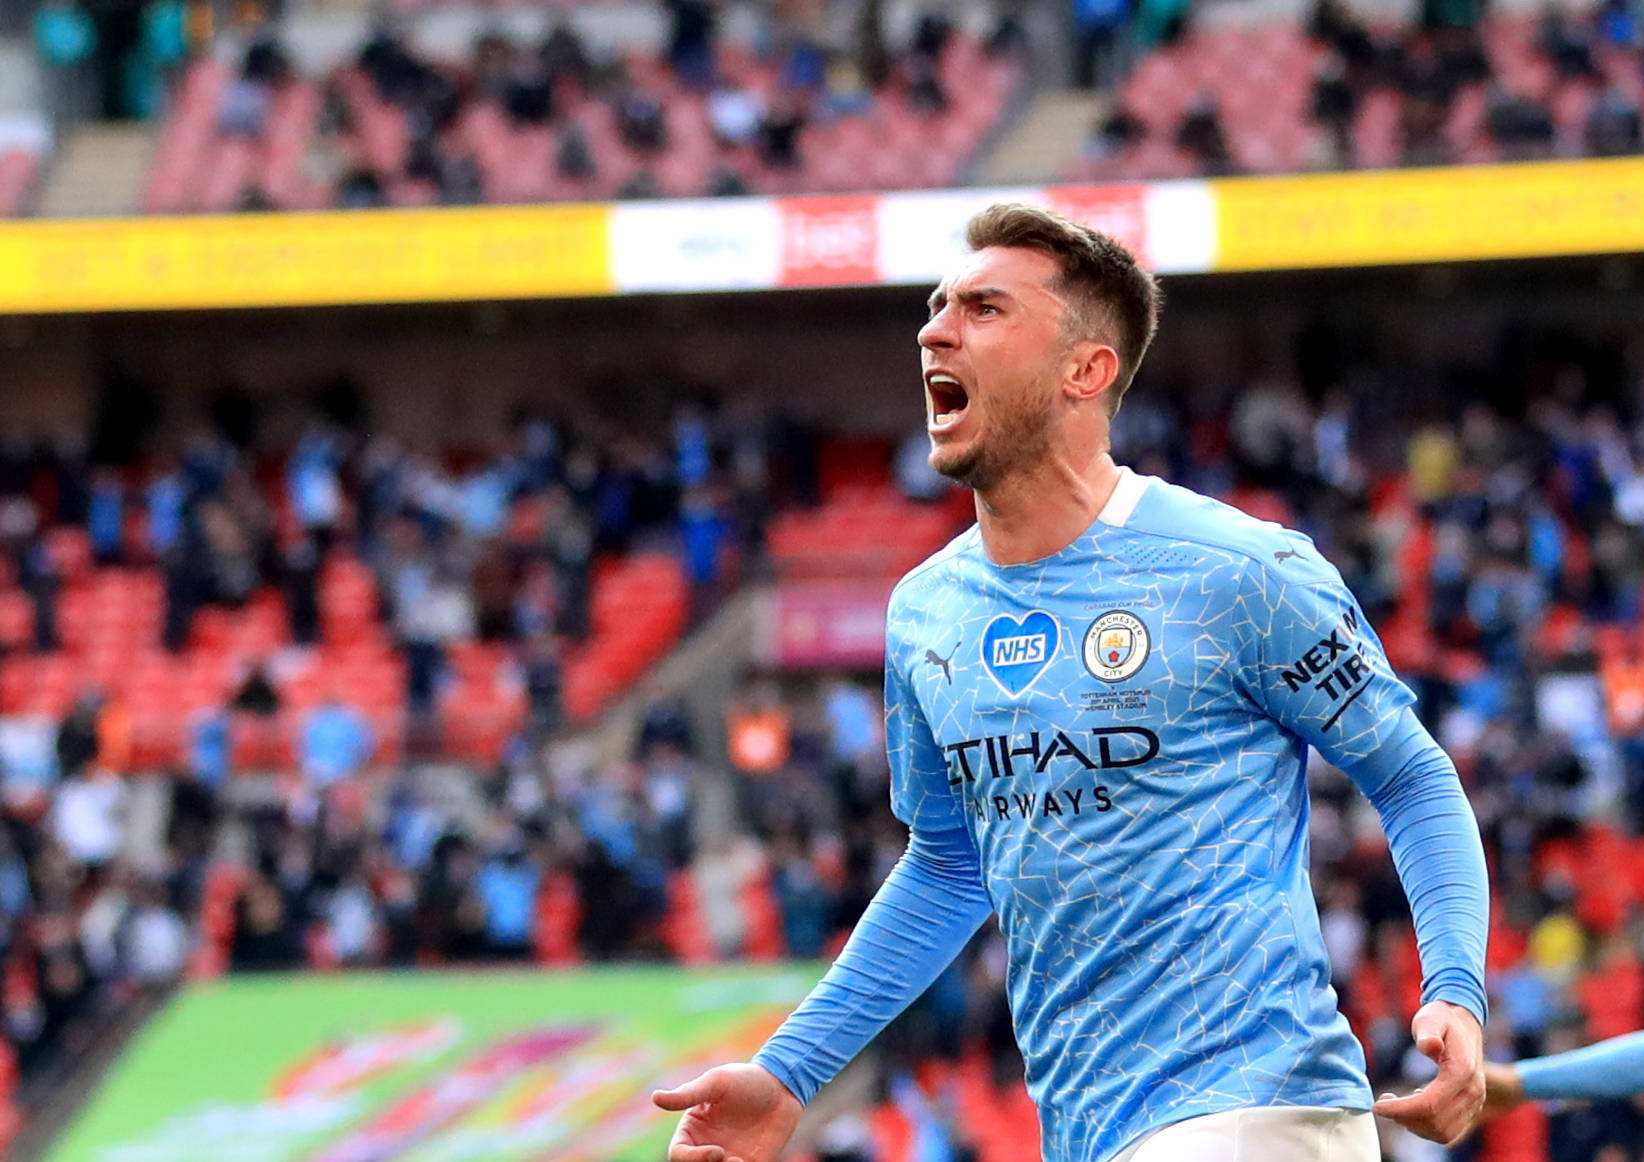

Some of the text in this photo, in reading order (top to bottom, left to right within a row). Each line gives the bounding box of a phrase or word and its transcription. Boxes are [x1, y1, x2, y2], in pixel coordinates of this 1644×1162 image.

[1090, 616, 1142, 639] MANCHESTER
[996, 639, 1042, 663] NHS
[1281, 606, 1360, 692] NEXN
[945, 726, 1160, 786] ETIHAD
[974, 785, 1112, 821] AIRWAYS
